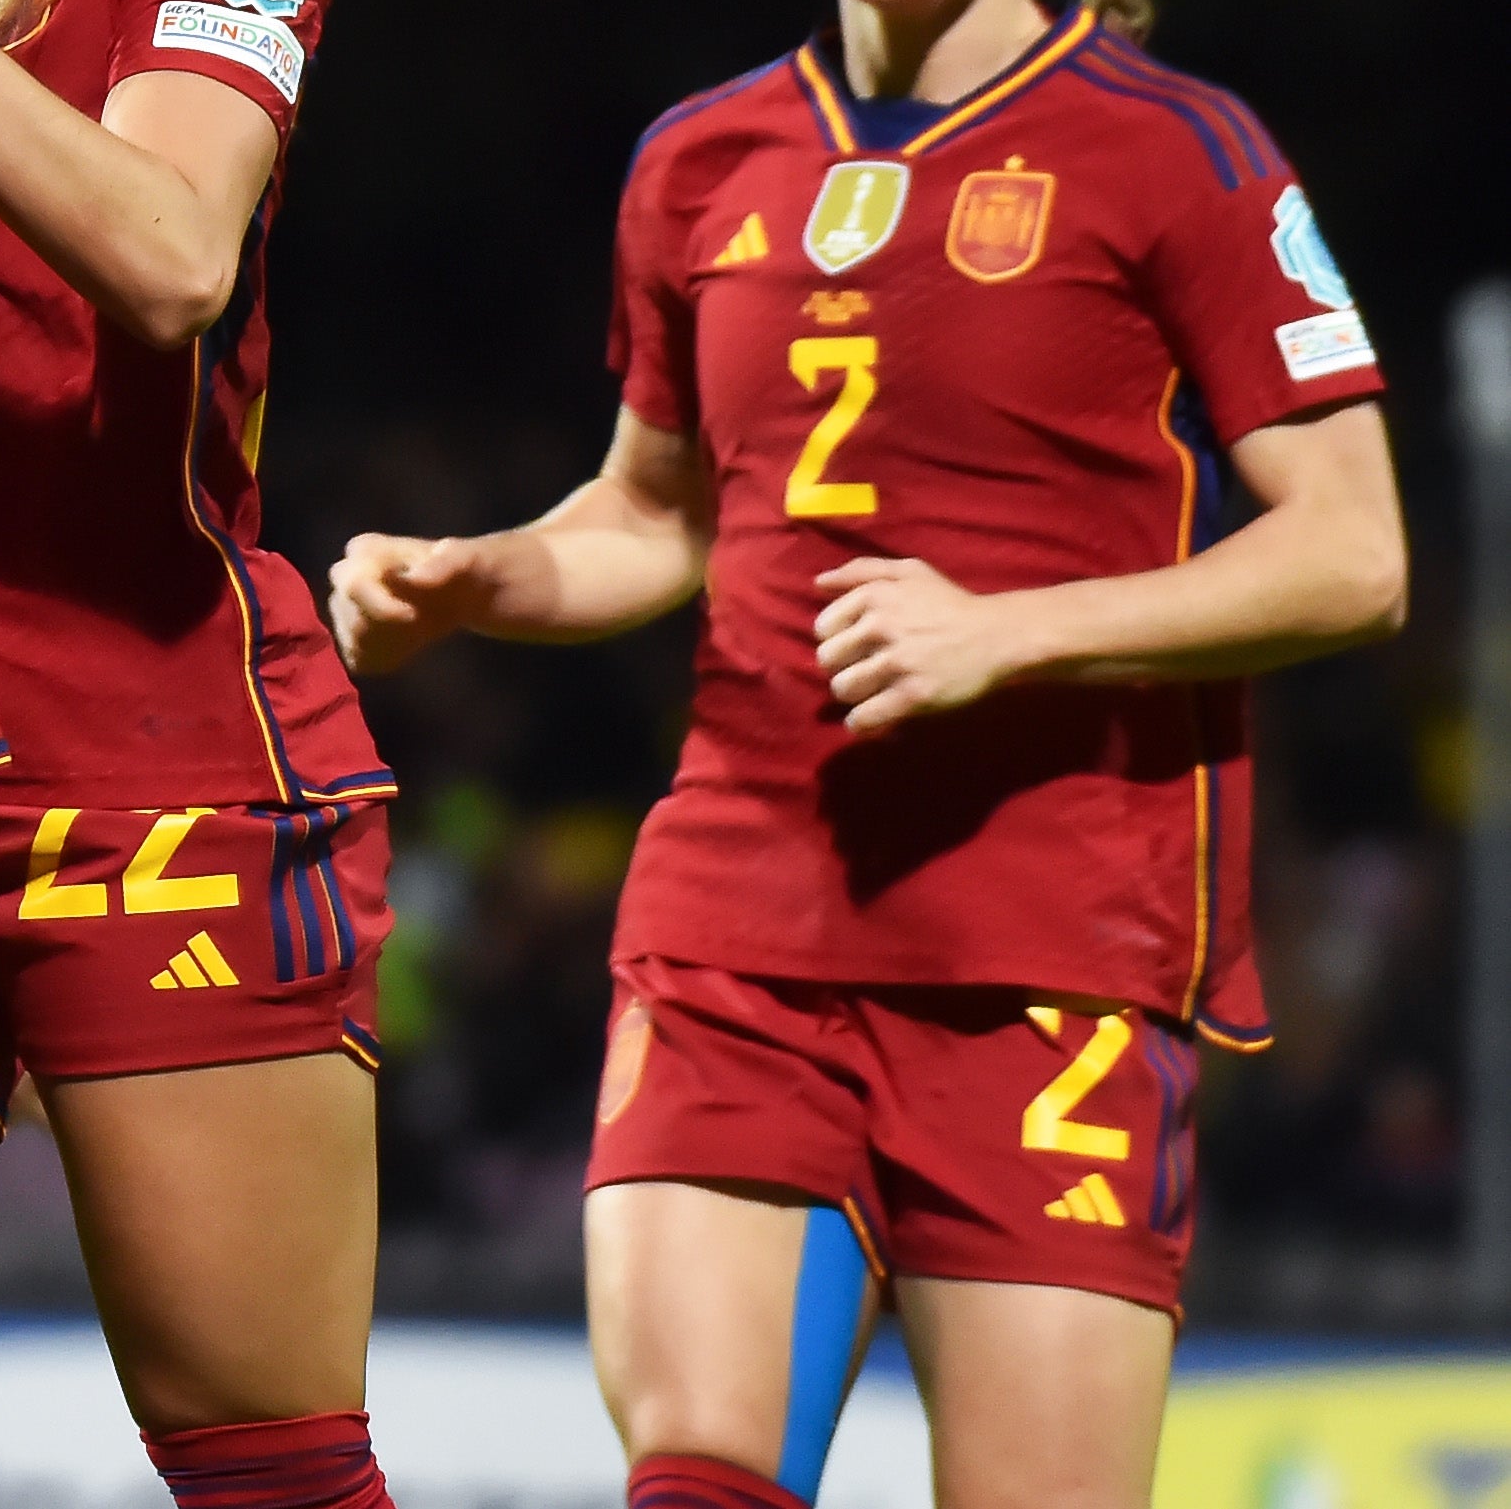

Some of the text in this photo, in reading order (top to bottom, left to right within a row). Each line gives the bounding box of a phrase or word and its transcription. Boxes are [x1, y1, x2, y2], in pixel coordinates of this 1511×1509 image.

[165, 3, 205, 15] UEFA
[786, 336, 878, 517] 2
[18, 807, 240, 920] 22
[1021, 1004, 1133, 1161] 2
